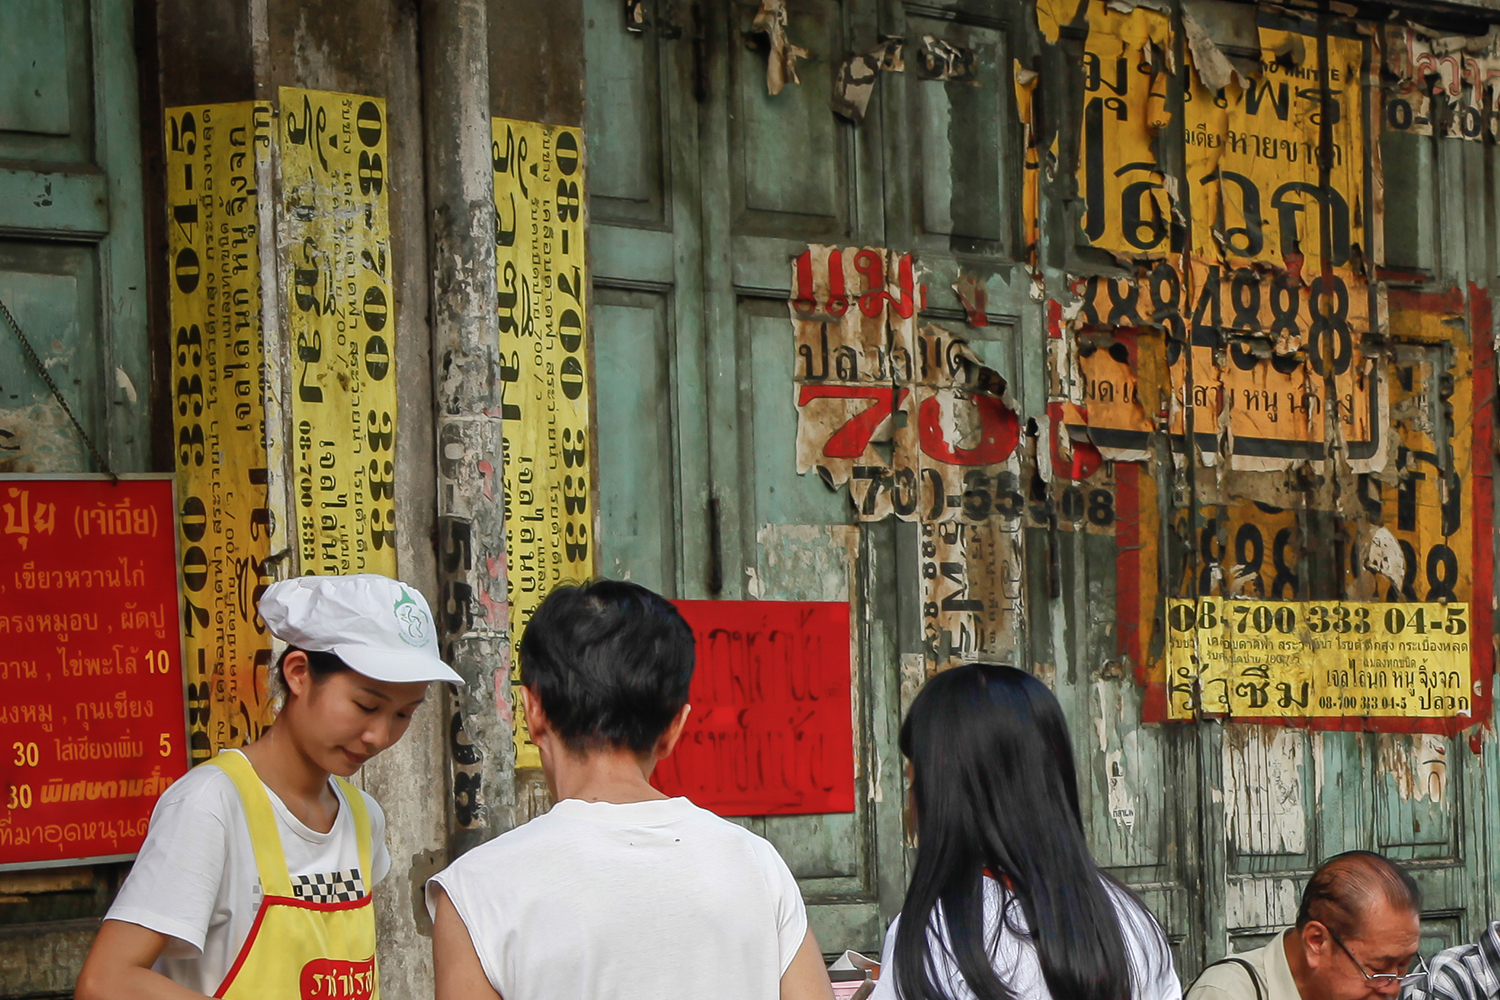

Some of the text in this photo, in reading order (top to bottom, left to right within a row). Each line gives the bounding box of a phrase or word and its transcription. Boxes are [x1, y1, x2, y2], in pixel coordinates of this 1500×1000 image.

[171, 112, 200, 294] 04-5
[357, 101, 396, 551] 08-700 333
[556, 131, 588, 563] 08-700 333
[176, 324, 205, 467] 333
[302, 516, 316, 560] 333
[14, 556, 145, 590] เขียวหวานไก่
[121, 602, 166, 639] ผัดปู
[1168, 601, 1467, 636] 08-700 333 04-5
[56, 644, 138, 677] ไข่พะโล้
[144, 649, 170, 674] 10
[75, 690, 154, 731] กุนเชียง
[1318, 696, 1357, 710] 08-700
[1418, 686, 1469, 711] ปลวก
[12, 741, 40, 767] 30
[158, 733, 172, 757] 5
[6, 784, 33, 810] 30
